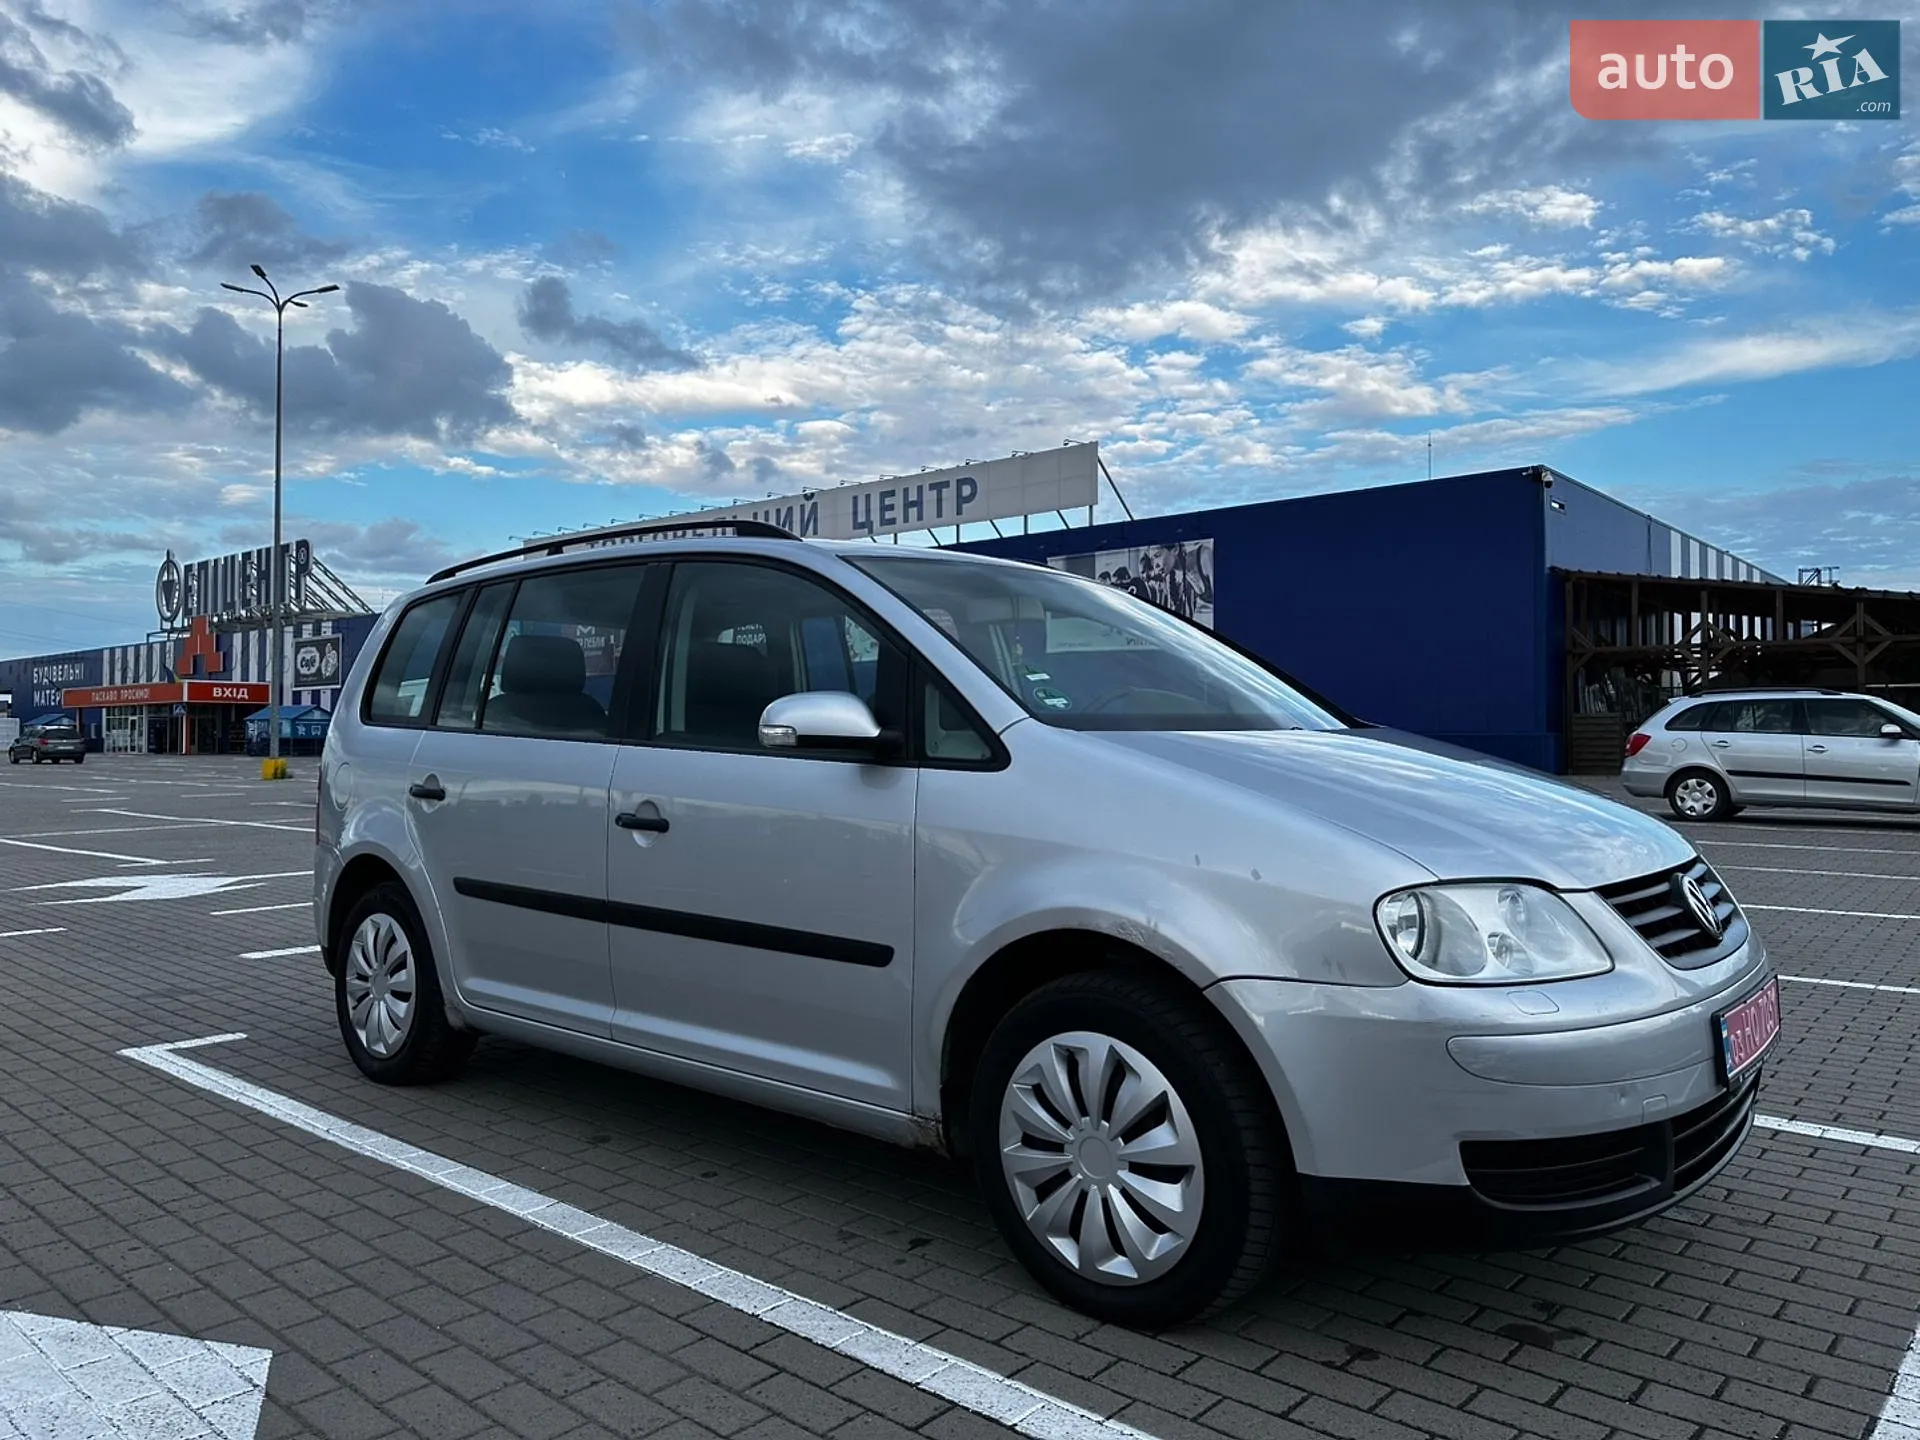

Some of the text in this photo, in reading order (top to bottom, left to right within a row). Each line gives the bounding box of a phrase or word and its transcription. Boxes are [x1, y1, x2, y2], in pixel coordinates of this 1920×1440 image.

[852, 477, 978, 535] ЦЕНТР
[33, 663, 84, 686] БУДІВЕЛЬНІ
[213, 687, 249, 700] ВХІД
